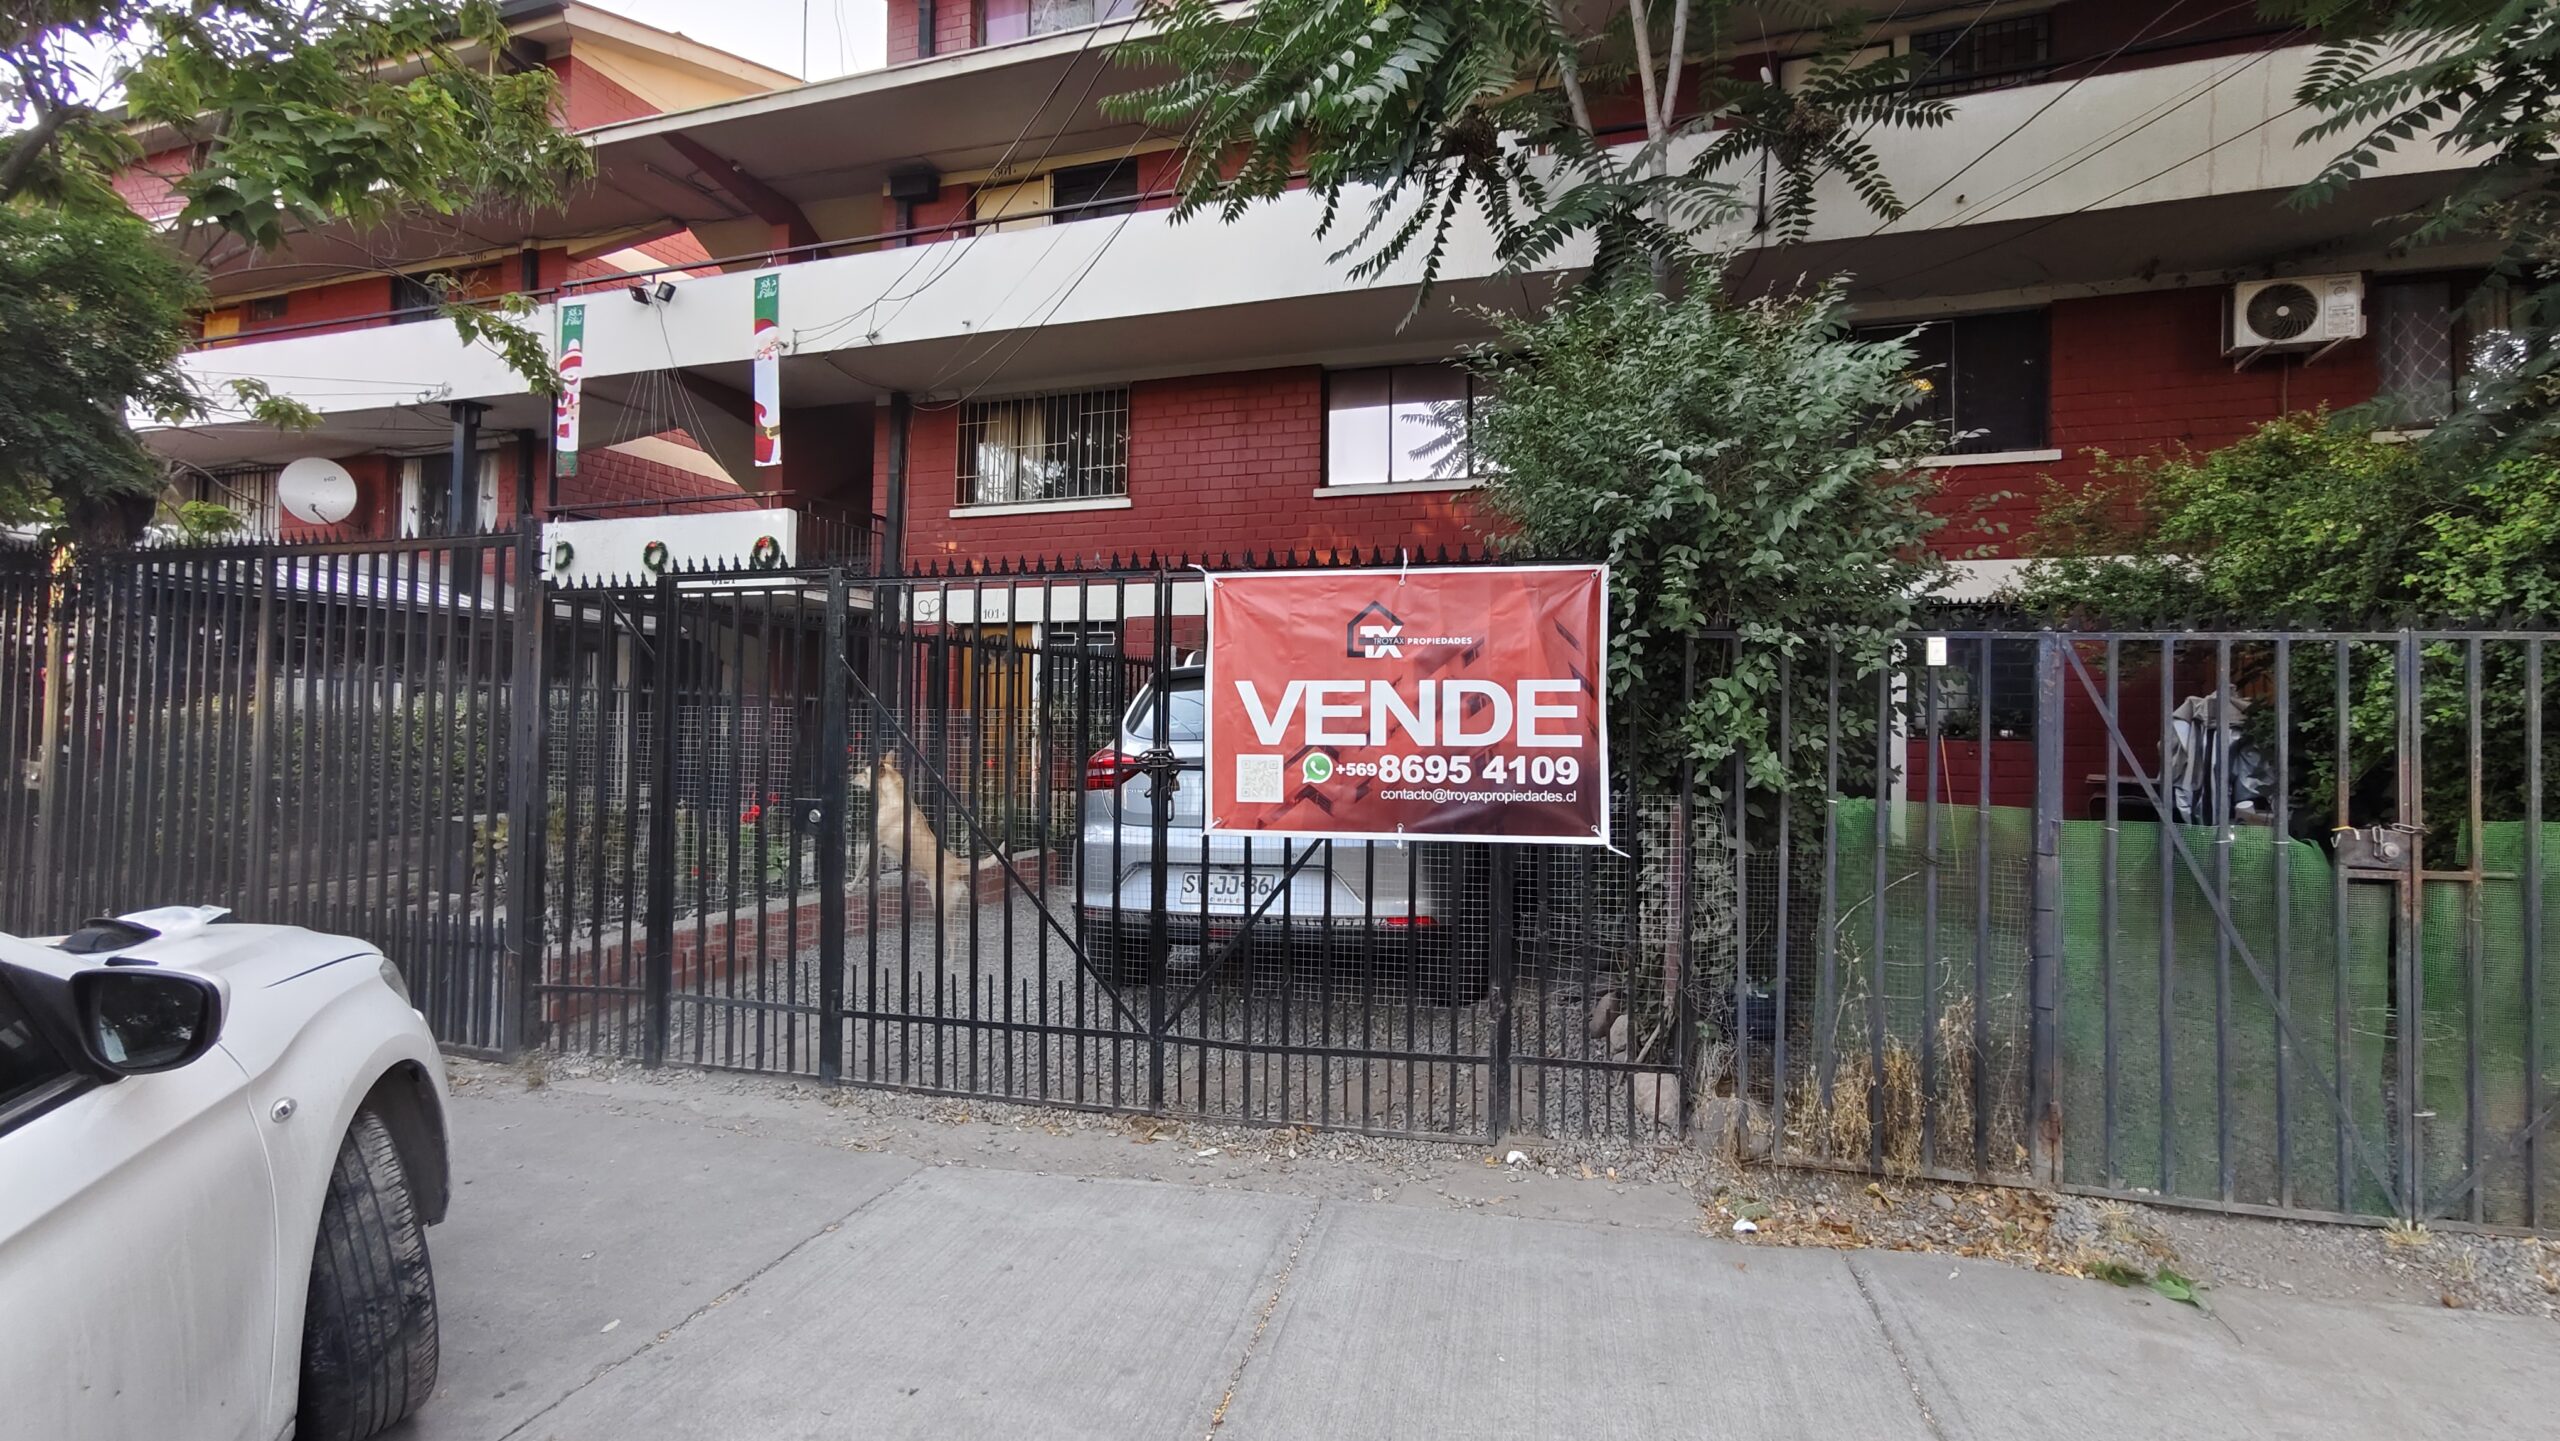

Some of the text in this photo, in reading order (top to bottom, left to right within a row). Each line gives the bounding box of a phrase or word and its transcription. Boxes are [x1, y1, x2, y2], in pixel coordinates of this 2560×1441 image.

[1407, 637, 1472, 645] PROPIEDADES
[1234, 679, 1582, 748] VENDE
[1335, 754, 1580, 785] +569 8695 4109
[1380, 788, 1577, 805] contacto@troyaxpropiedades.cl
